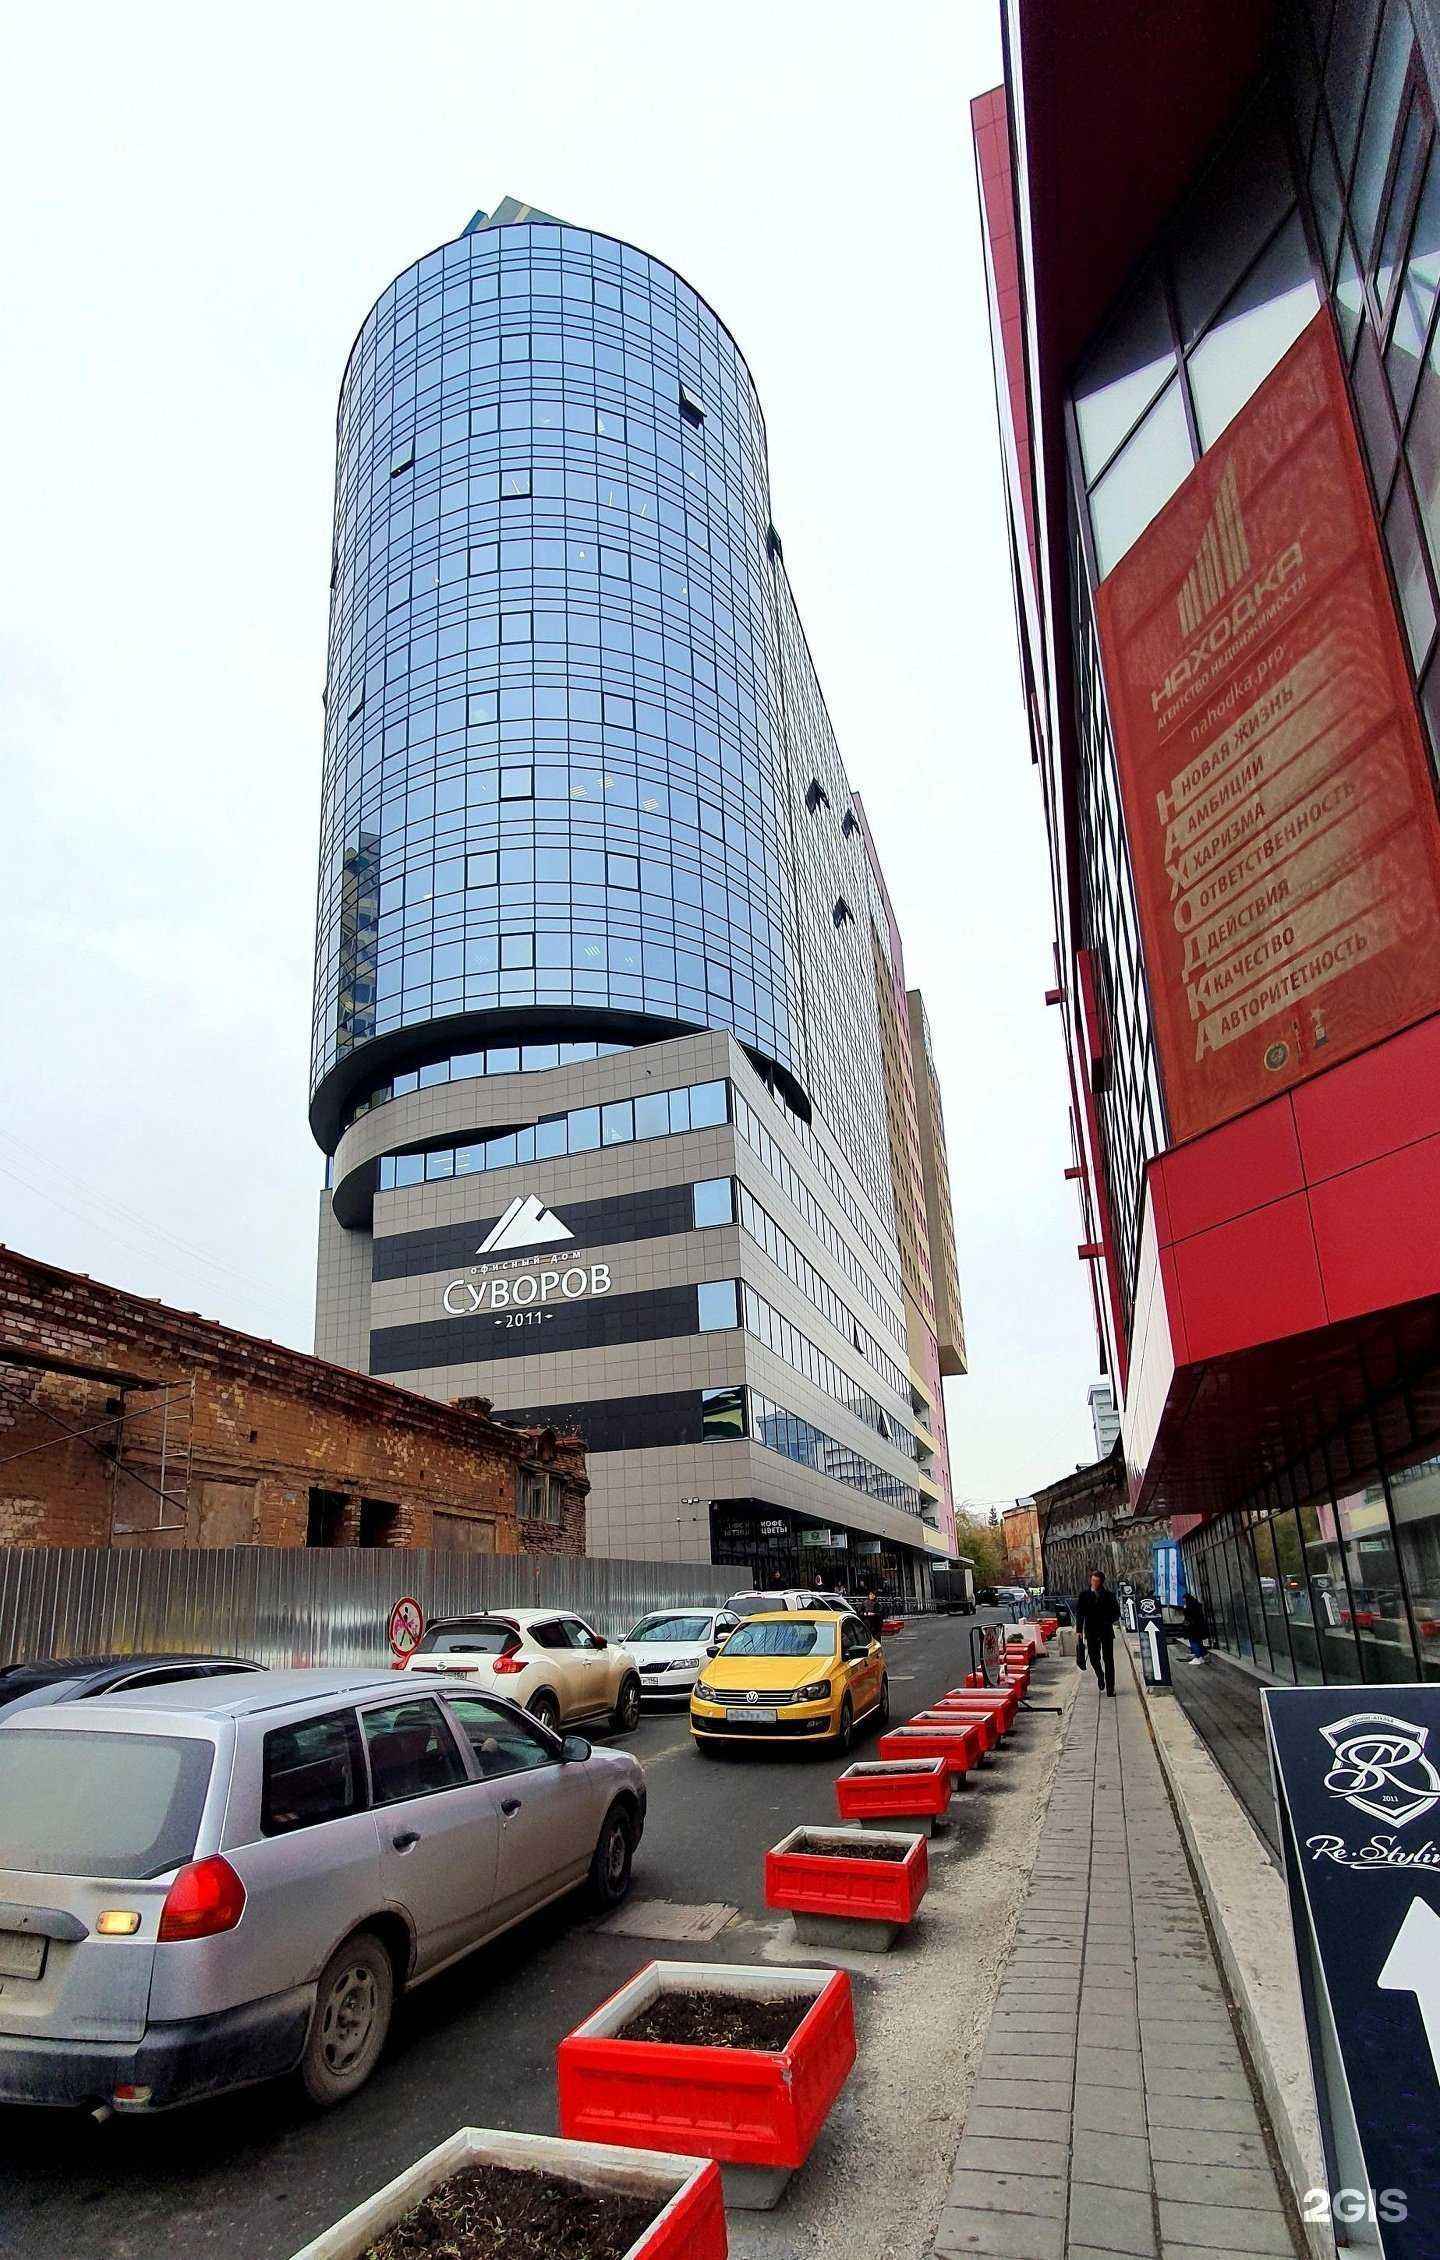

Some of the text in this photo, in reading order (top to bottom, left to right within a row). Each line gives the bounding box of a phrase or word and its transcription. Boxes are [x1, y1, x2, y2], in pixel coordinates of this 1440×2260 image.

[1190, 646, 1284, 743] nahodka.pro
[1181, 687, 1294, 797] НОВАЯ ЖИЗНЬ
[1187, 754, 1265, 834] АМБИЦИИ
[1193, 802, 1266, 871] ХАРИЗМА
[1200, 780, 1355, 908] ОТВЕТСТВЕННОСТЬ
[1207, 878, 1290, 955] ДЕЙСТВИЯ
[1213, 926, 1295, 994] КАЧЕСТВО
[1221, 931, 1369, 1035] АВТОРИТЕТНОСТЬ
[443, 1263, 612, 1316] СУВОРОВ
[761, 1526, 788, 1535] ЦВЕТЫ
